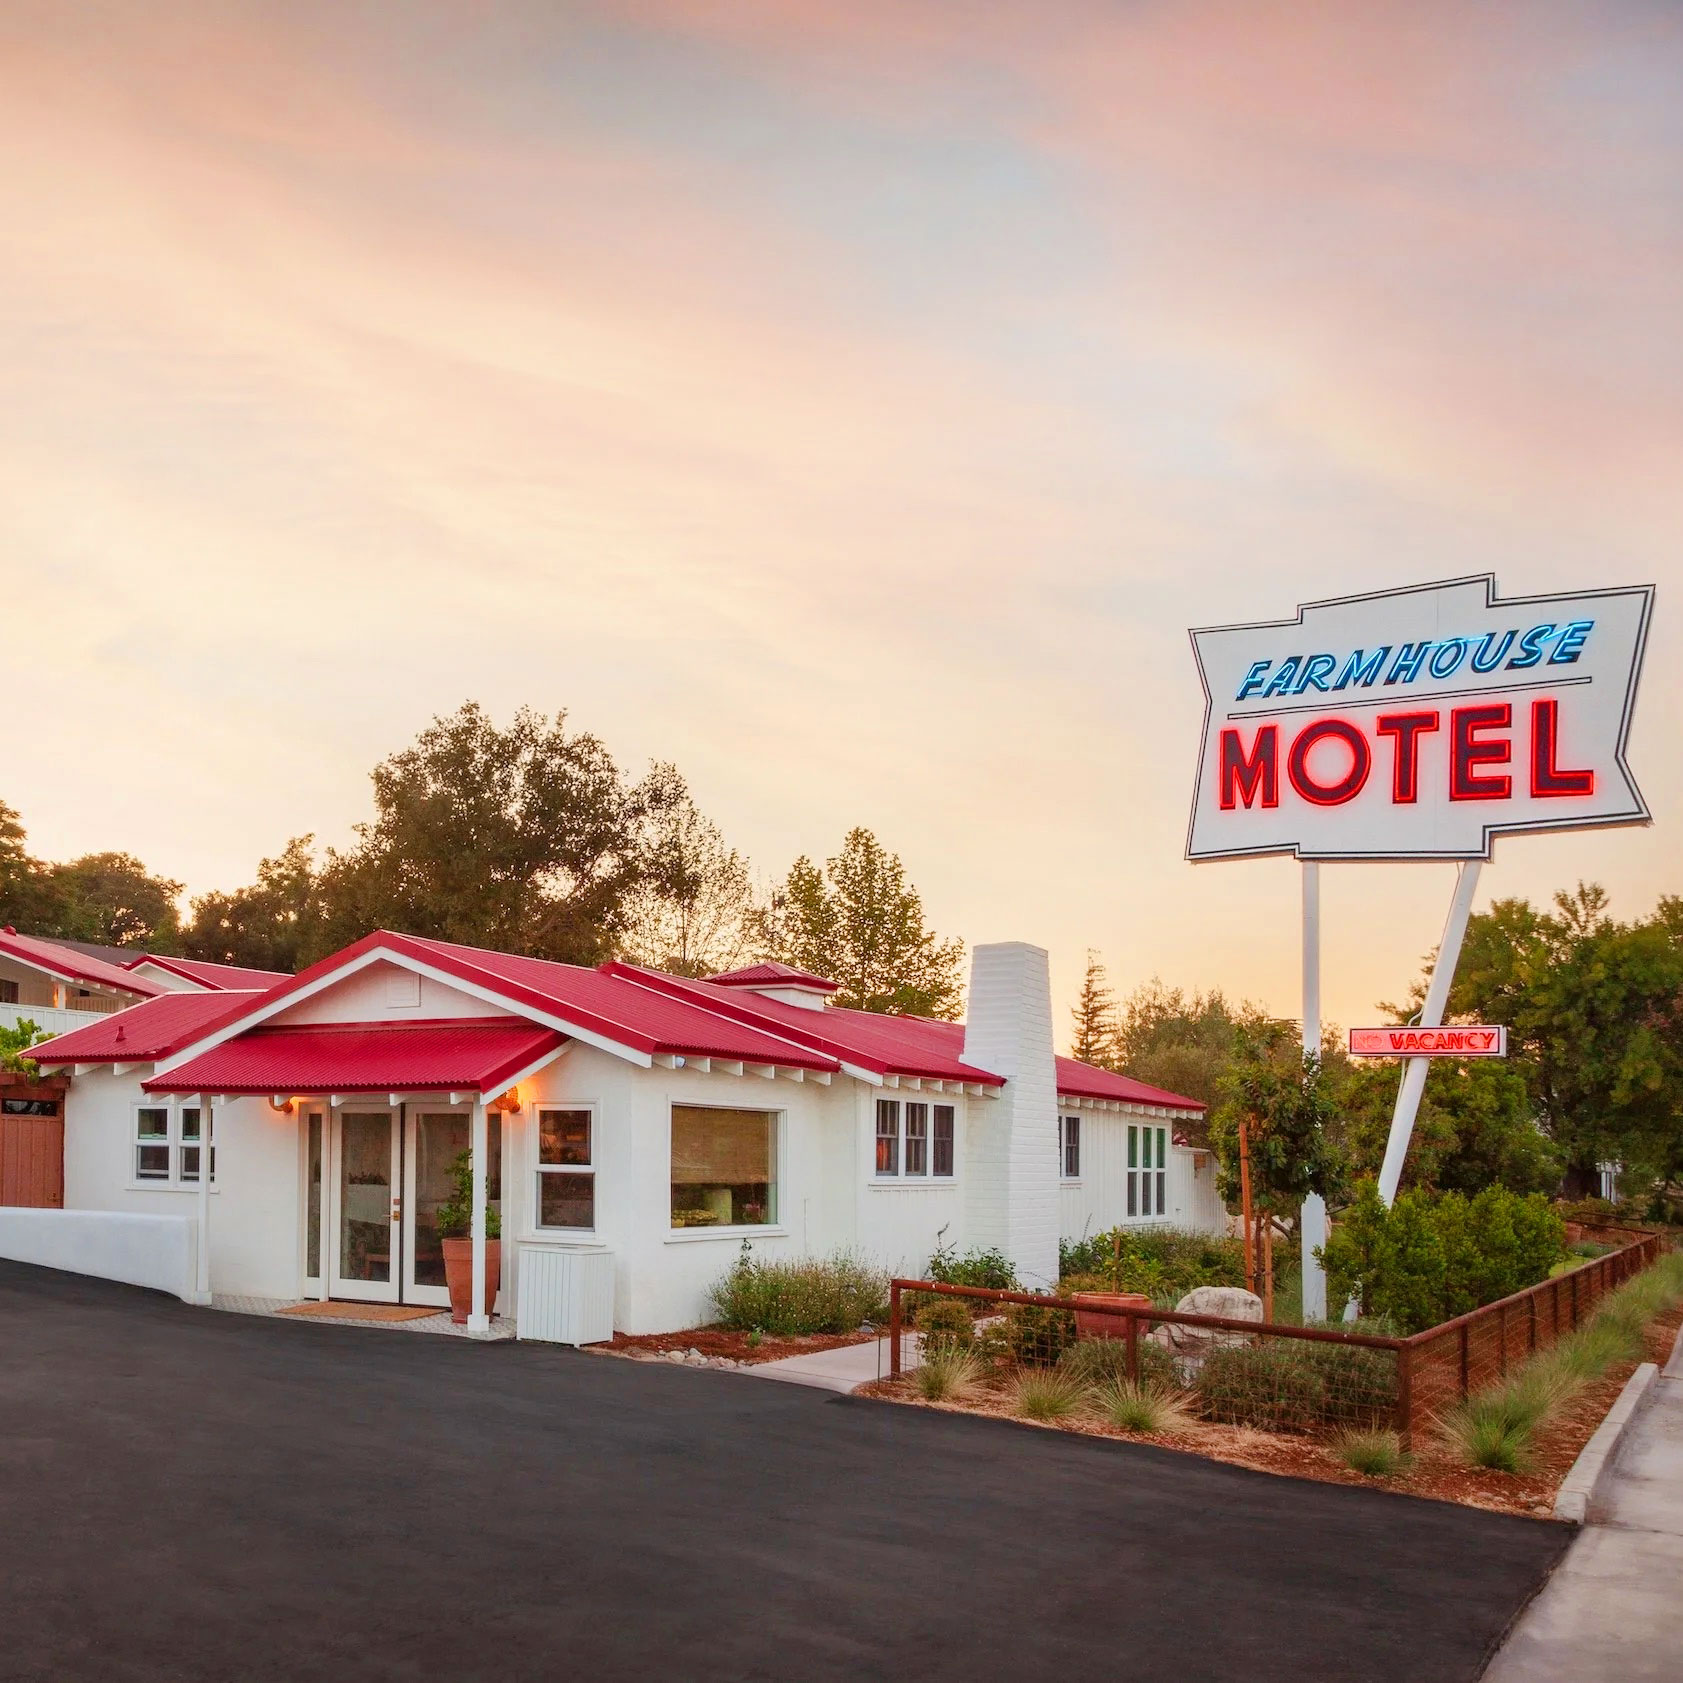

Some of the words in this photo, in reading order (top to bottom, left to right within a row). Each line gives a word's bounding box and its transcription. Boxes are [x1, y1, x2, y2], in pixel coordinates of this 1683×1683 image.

[1235, 620, 1595, 701] FARMHOUSE
[1219, 700, 1595, 810] MOTEL
[1353, 1035, 1383, 1049] NO
[1389, 1032, 1496, 1049] VACANCY
